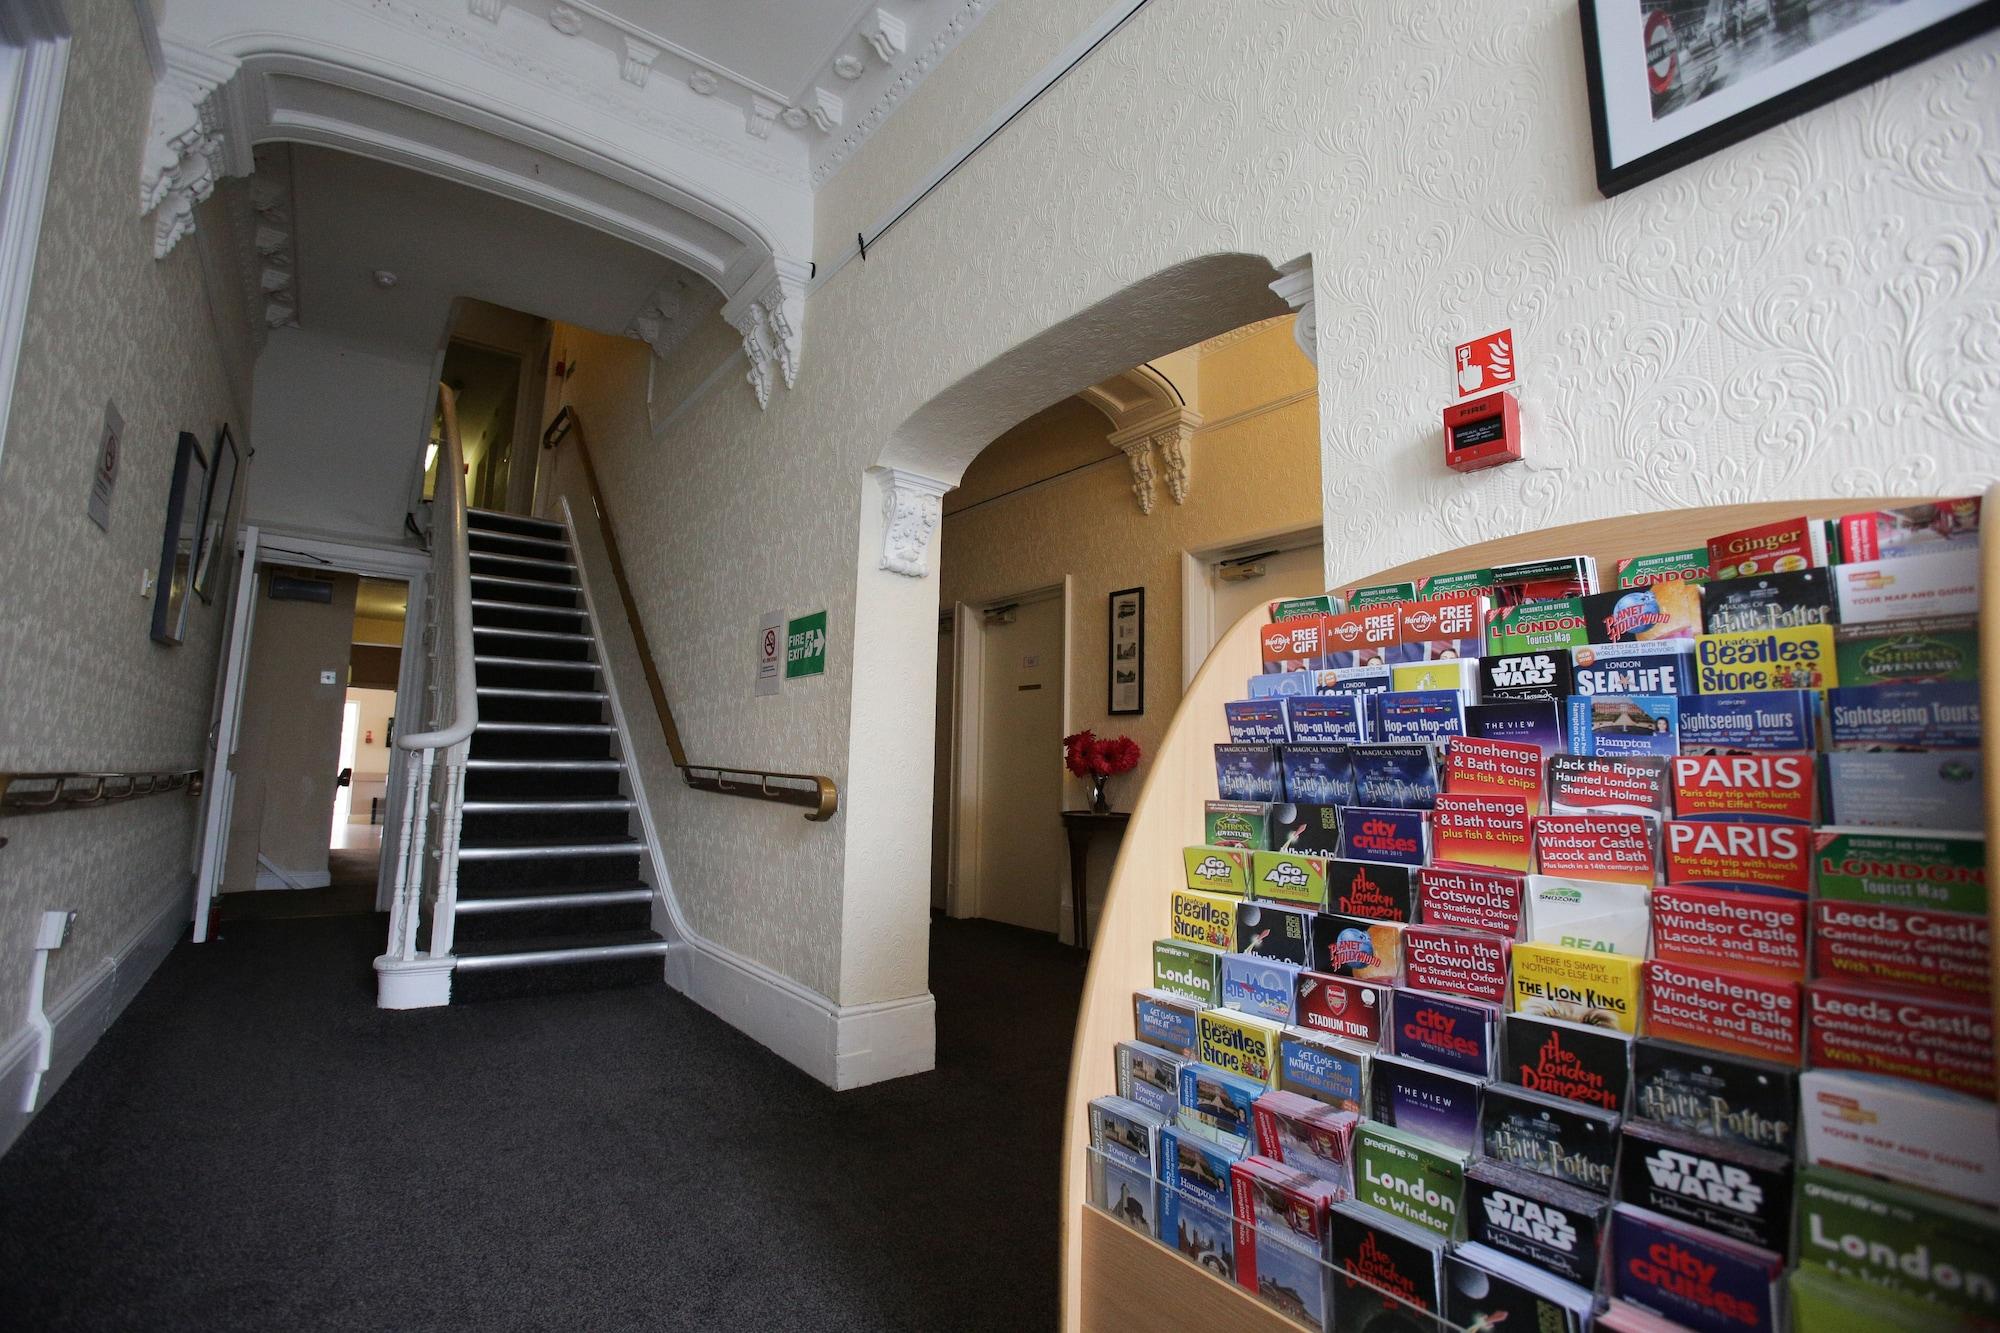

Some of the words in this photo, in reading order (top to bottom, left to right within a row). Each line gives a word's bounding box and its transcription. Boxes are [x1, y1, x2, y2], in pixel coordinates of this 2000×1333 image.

[1460, 403, 1488, 416] FIRE
[1729, 529, 1801, 555] Ginger
[1852, 596, 1881, 605] YOUR
[1884, 592, 1909, 603] MAP
[1910, 590, 1935, 599] AND
[1937, 586, 1976, 597] GUIDE
[1520, 606, 1541, 614] DISCOUNTS
[1554, 602, 1570, 610] OFFERS
[1365, 614, 1395, 630] FREE
[1505, 616, 1588, 636] LONDON
[1604, 604, 1645, 635] PLANET
[1611, 612, 1672, 642] HOLLYWOOD
[789, 633, 805, 647] FIRE
[1292, 628, 1318, 641] FREE
[1365, 627, 1395, 642] GIFT
[788, 648, 804, 661] EXIT
[1293, 640, 1318, 654] GIFT
[1596, 648, 1620, 657] WORLD'S
[1621, 647, 1639, 655] GREAT
[1640, 644, 1675, 654] SURVIVORS
[1699, 636, 1820, 665] Beatles
[1491, 655, 1556, 673] STAR
[1605, 660, 1641, 669] LONDON
[1491, 668, 1556, 687] WARS
[1702, 665, 1768, 692] Store
[1680, 711, 1752, 732] Sightseeing
[1755, 709, 1793, 730] Tours
[1834, 706, 1928, 726] Sightseeing
[1932, 702, 1980, 725] Tours
[1293, 722, 1322, 734] Hop-on
[1324, 721, 1356, 733] Hop-off
[1451, 740, 1538, 762] Stonehenge
[1595, 737, 1651, 750] Hampton
[1453, 756, 1464, 768] &
[1467, 758, 1497, 772] Bath
[1500, 762, 1536, 777] tours
[1555, 758, 1584, 770] Jack
[1588, 758, 1609, 772] the
[1614, 761, 1661, 778] Ripper
[1676, 758, 1801, 789] PARIS
[1556, 773, 1601, 785] Haunted
[1604, 778, 1647, 790] London
[1650, 781, 1659, 792] &
[1560, 784, 1606, 797] Sherlock
[1609, 790, 1653, 803] Holmes
[1679, 789, 1703, 797] Paris
[1705, 788, 1724, 800] day
[1725, 788, 1745, 800] trip
[1747, 789, 1769, 799] with
[1771, 790, 1801, 799] lunch
[1436, 798, 1525, 816] Stonehenge
[1707, 800, 1724, 808] the
[1727, 800, 1752, 809] Eiffel
[1755, 800, 1788, 810] Tower
[1361, 819, 1397, 837] city
[1441, 815, 1451, 826] &
[1455, 816, 1484, 828] Bath
[1487, 817, 1523, 830] tours
[1353, 835, 1417, 853] cruises
[1442, 828, 1463, 840] plus
[1465, 829, 1484, 840] fish
[1485, 831, 1494, 840] &
[1496, 832, 1525, 843] chips
[1538, 837, 1597, 849] Windsor
[1600, 838, 1644, 849] Castle
[1669, 824, 1798, 860] PARIS
[1205, 856, 1225, 868] Go
[1542, 850, 1584, 861] Lacock
[1588, 850, 1612, 862] and
[1615, 851, 1646, 863] Bath
[1543, 861, 1556, 869] Plus
[1557, 861, 1575, 869] lunch
[1590, 862, 1606, 870] 14th
[1607, 864, 1634, 872] century
[1196, 864, 1231, 879] Ape!
[1265, 872, 1309, 886] Ape!
[1354, 868, 1376, 891] the
[1422, 873, 1465, 889] Lunch
[1470, 879, 1484, 891] in
[1488, 881, 1514, 897] the
[1862, 879, 1914, 894] Tourist
[1917, 883, 1949, 900] Map
[1429, 886, 1510, 909] Cotswolds
[1539, 894, 1581, 904] SNOZONE
[1339, 895, 1402, 921] Dungeon
[1424, 900, 1442, 910] Plus
[1443, 903, 1484, 917] Stratford,
[1486, 908, 1518, 921] Oxford
[1433, 911, 1441, 919] &
[1442, 912, 1480, 925] Warwick
[1482, 919, 1509, 930] Castle
[1662, 914, 1733, 935] Windsor
[1738, 923, 1797, 943] Castle
[1822, 906, 1899, 931] Leeds
[1905, 916, 1989, 945] Castle
[1156, 946, 1181, 957] greenline
[1561, 936, 1616, 952] REAL
[1663, 930, 1717, 948] Lacock
[1722, 937, 1753, 953] and
[1758, 941, 1798, 958] Bath
[1157, 962, 1210, 991] London
[1419, 974, 1428, 983] &
[1428, 976, 1466, 990] Warwick
[1467, 983, 1496, 995] Castle
[1308, 1013, 1343, 1031] STADIUM
[1345, 1023, 1369, 1038] TOUR
[1415, 1009, 1457, 1034] city
[1812, 993, 1891, 1022] Leeds
[1898, 1007, 1990, 1040] Castle
[1201, 1018, 1266, 1057] Beatles
[1403, 1023, 1480, 1057] cruises
[1289, 1057, 1318, 1074] NATURE
[1134, 1081, 1154, 1097] Tower
[1155, 1092, 1164, 1101] of
[1397, 1084, 1418, 1098] THE
[1422, 1091, 1453, 1108] VIEW
[1520, 1064, 1617, 1111] Dungeon
[1364, 1137, 1407, 1158] greenline
[1494, 1130, 1544, 1160] Harry
[1547, 1140, 1612, 1186] Potter
[1365, 1159, 1456, 1214] London
[1373, 1191, 1388, 1206] to
[1389, 1195, 1448, 1233] Windsor
